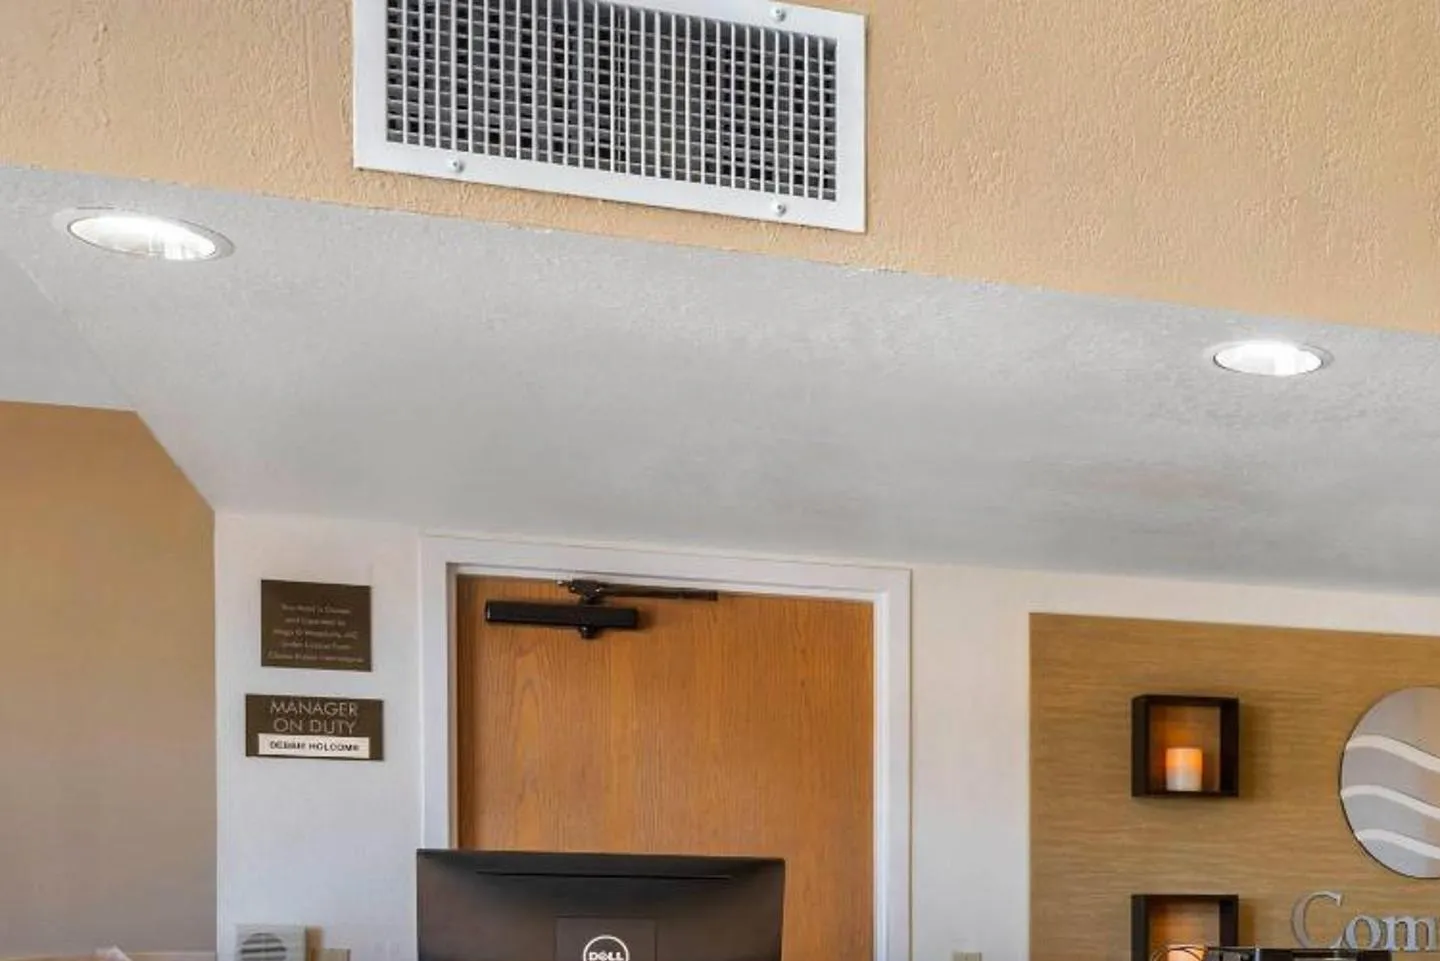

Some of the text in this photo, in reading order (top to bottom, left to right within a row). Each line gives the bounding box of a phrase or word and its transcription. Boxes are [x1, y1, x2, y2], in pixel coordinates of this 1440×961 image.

[270, 700, 358, 717] MANAGER
[273, 717, 357, 735] ON DUTY
